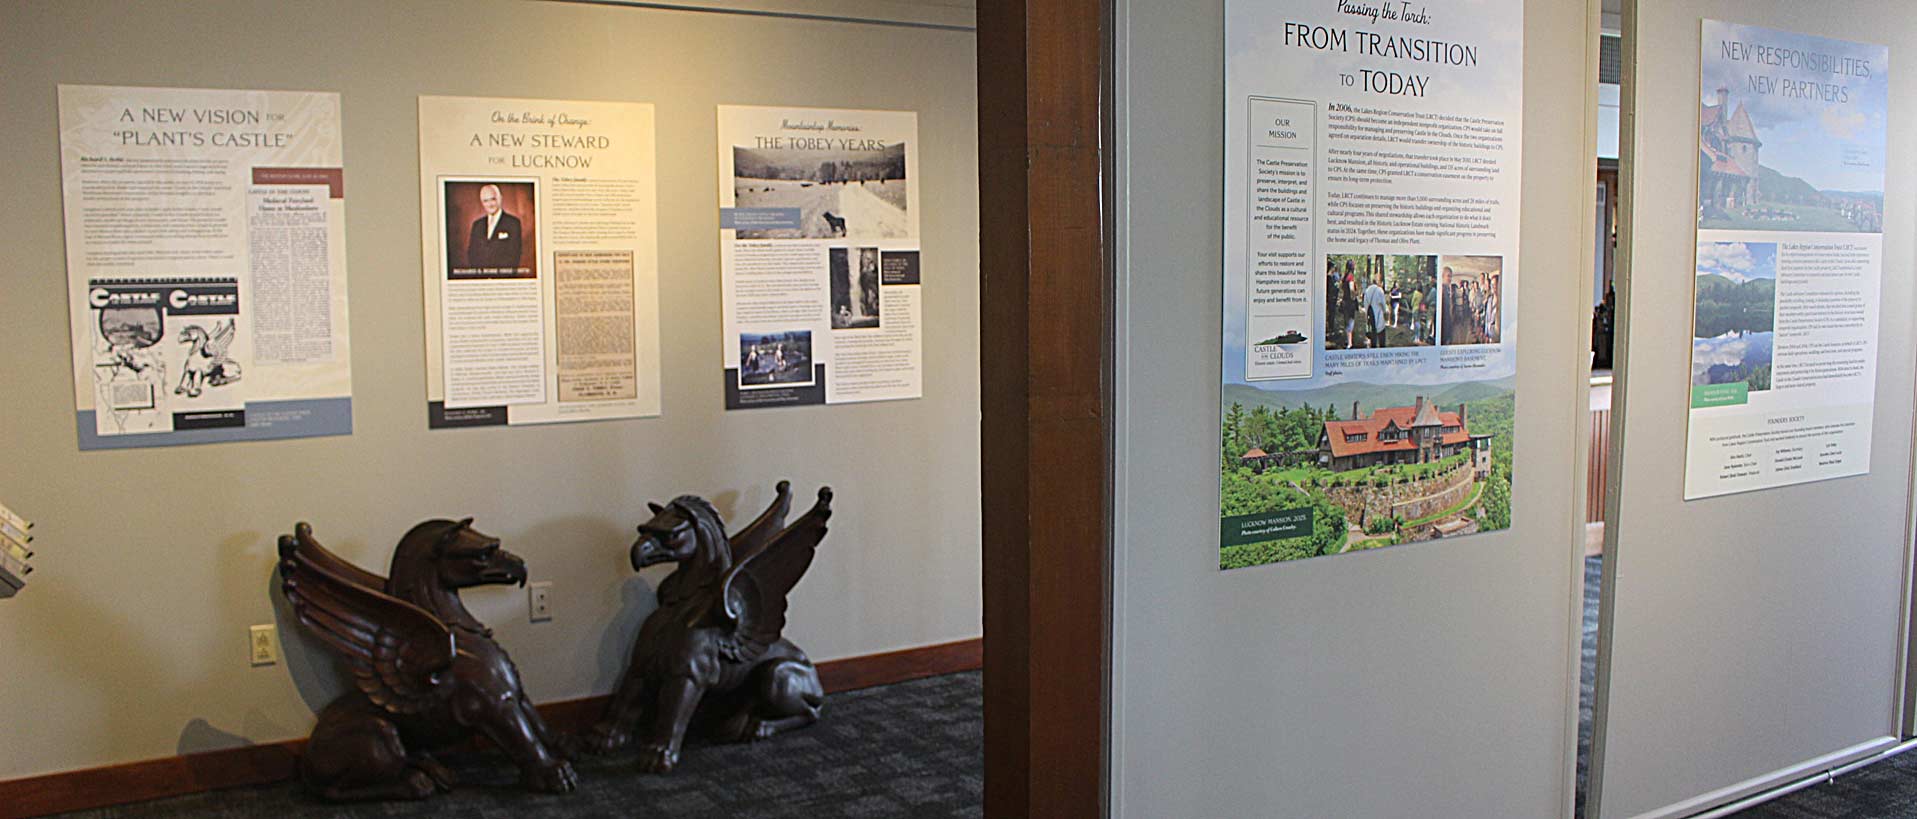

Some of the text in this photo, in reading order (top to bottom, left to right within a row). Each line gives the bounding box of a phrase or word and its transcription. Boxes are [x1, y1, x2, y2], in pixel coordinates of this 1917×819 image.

[1338, 0, 1431, 25] Passing the Torch:
[1284, 22, 1477, 66] FROM TRANSITION
[1722, 40, 1872, 79] NEW RESPONSIBILITIES,
[1339, 70, 1430, 97] TO TODAY
[1748, 75, 1848, 103] NEW PARTNERS
[1328, 103, 1335, 111] In
[120, 108, 134, 122] A
[143, 109, 186, 122] NEW
[193, 110, 259, 124] VISION
[492, 111, 504, 123] On
[508, 113, 519, 124] the
[522, 112, 544, 124] Brink
[548, 115, 555, 126] of
[470, 133, 609, 148] A NEW STEWARD
[1268, 130, 1296, 139] MISSION
[755, 136, 885, 151] THE TOBEY YEARS
[512, 155, 592, 168] LUCKNOW
